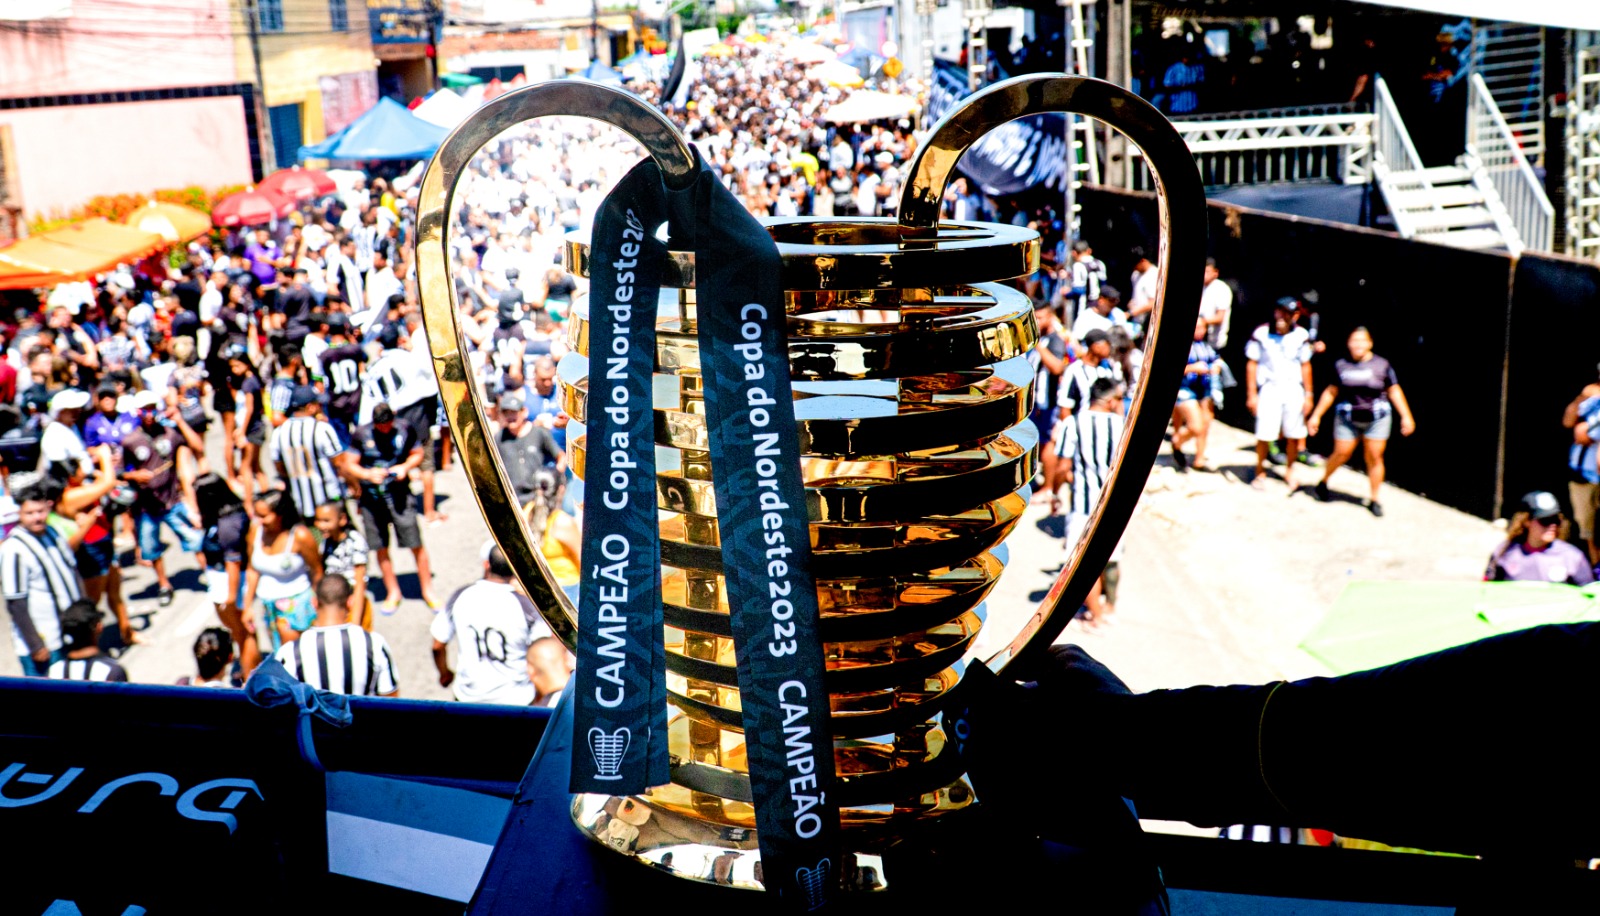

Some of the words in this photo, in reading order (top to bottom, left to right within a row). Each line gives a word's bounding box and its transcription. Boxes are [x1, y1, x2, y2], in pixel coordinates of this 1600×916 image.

[733, 303, 768, 381] Copa
[330, 359, 358, 394] 10
[604, 386, 630, 425] do
[746, 386, 777, 427] do
[603, 431, 637, 510] Copa
[468, 625, 508, 663] 10
[593, 533, 630, 708] CAMPEÃO
[778, 680, 826, 838] CAMPEÃO
